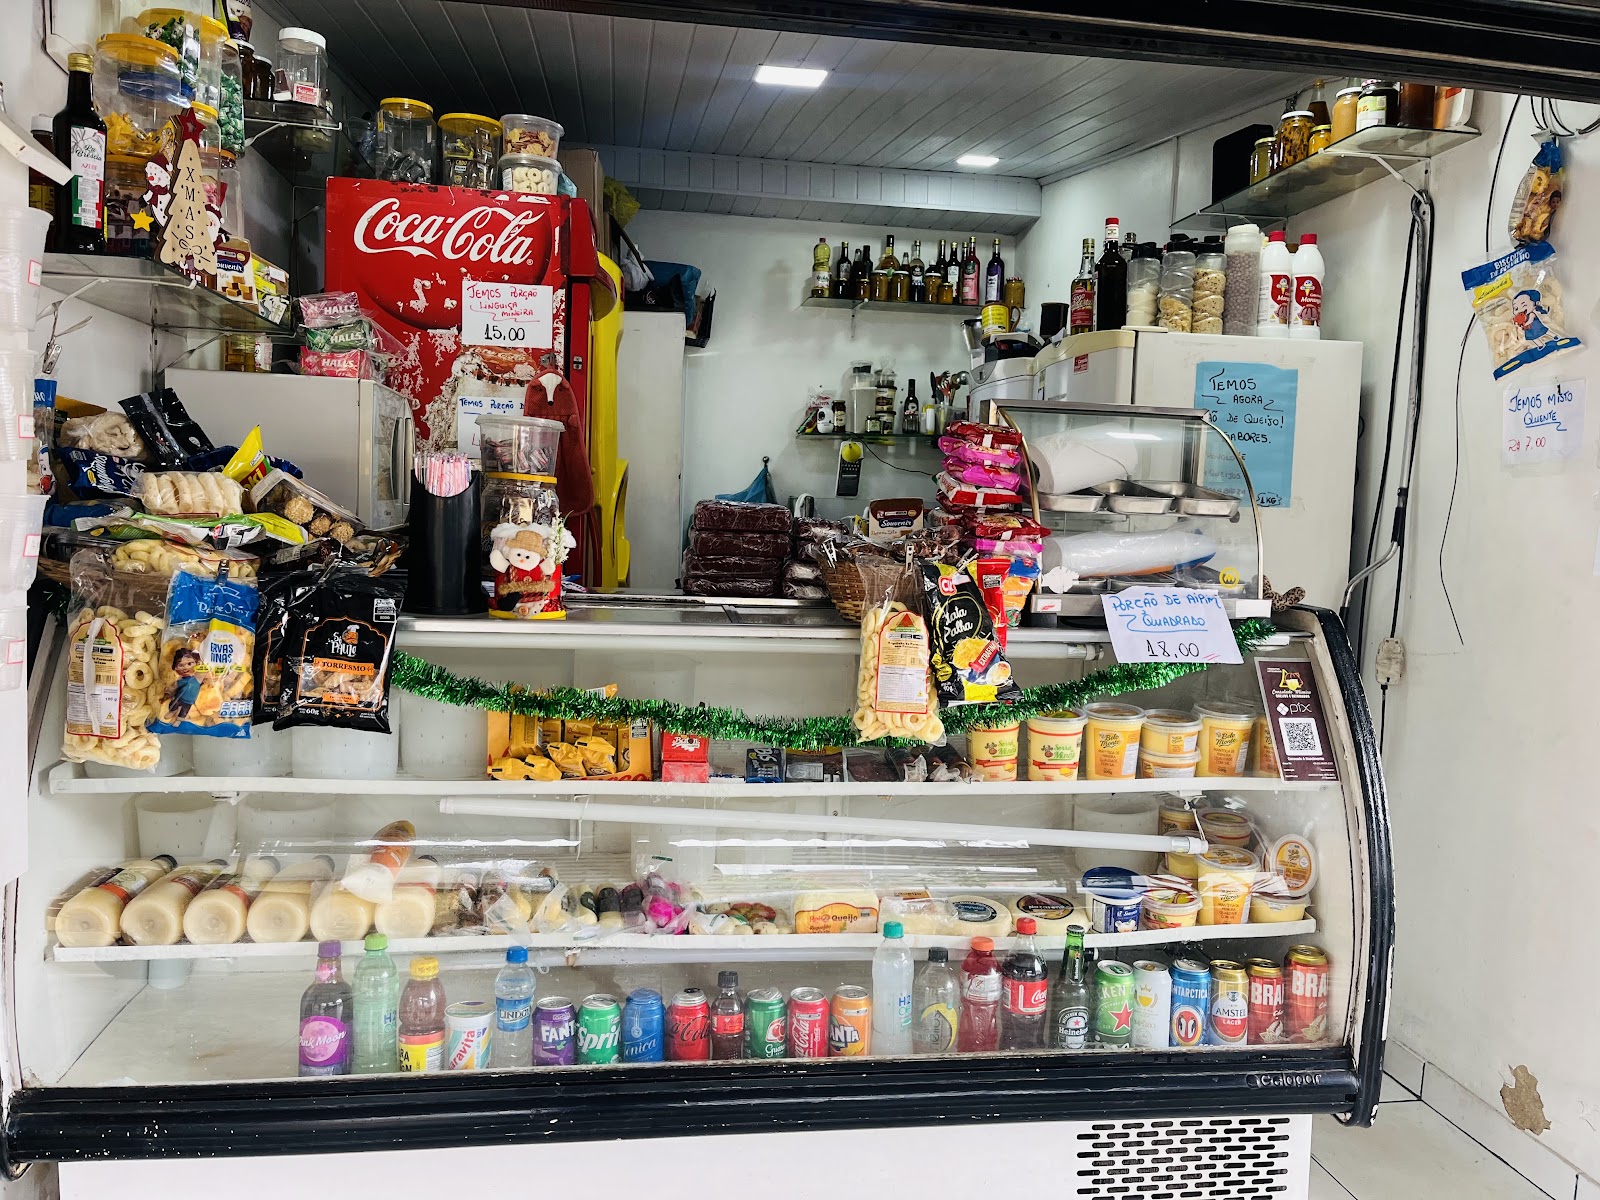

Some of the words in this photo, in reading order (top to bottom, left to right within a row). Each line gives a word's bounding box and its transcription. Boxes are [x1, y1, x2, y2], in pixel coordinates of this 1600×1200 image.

[184, 166, 196, 240] XMAS
[354, 198, 545, 265] Coca-Cola
[217, 260, 244, 273] ouvenir
[510, 285, 538, 300] PORÇÃO
[324, 304, 356, 315] HALLS
[330, 332, 363, 344] HALLS
[321, 358, 354, 368] HALLS
[1209, 368, 1257, 391] TEMOS
[459, 397, 483, 408] TEMOS
[490, 398, 514, 413] PORÇÃO
[1233, 395, 1263, 405] AGORA
[1508, 389, 1542, 412] TEMOS
[1547, 390, 1573, 406] MISTO
[1208, 410, 1218, 423] ÃO
[1226, 413, 1238, 423] DE
[1523, 410, 1557, 426] QUENTE
[881, 519, 912, 528] Souvenir
[1108, 592, 1158, 614] PORÇÃO
[1163, 593, 1182, 606] DE
[1141, 613, 1206, 628] QUADRADO
[321, 661, 367, 672] TORRESMO
[1289, 702, 1313, 715] pix
[1221, 732, 1236, 740] Belo
[831, 913, 858, 923] Queijo
[1101, 983, 1126, 999] KEN
[1291, 969, 1328, 998] BRA
[1222, 1018, 1242, 1026] LAGER
[541, 1020, 576, 1043] FANT
[829, 1024, 860, 1043] ANTA
[299, 1035, 315, 1049] Pink
[315, 1031, 347, 1047] Moon
[448, 1030, 475, 1071] aravita
